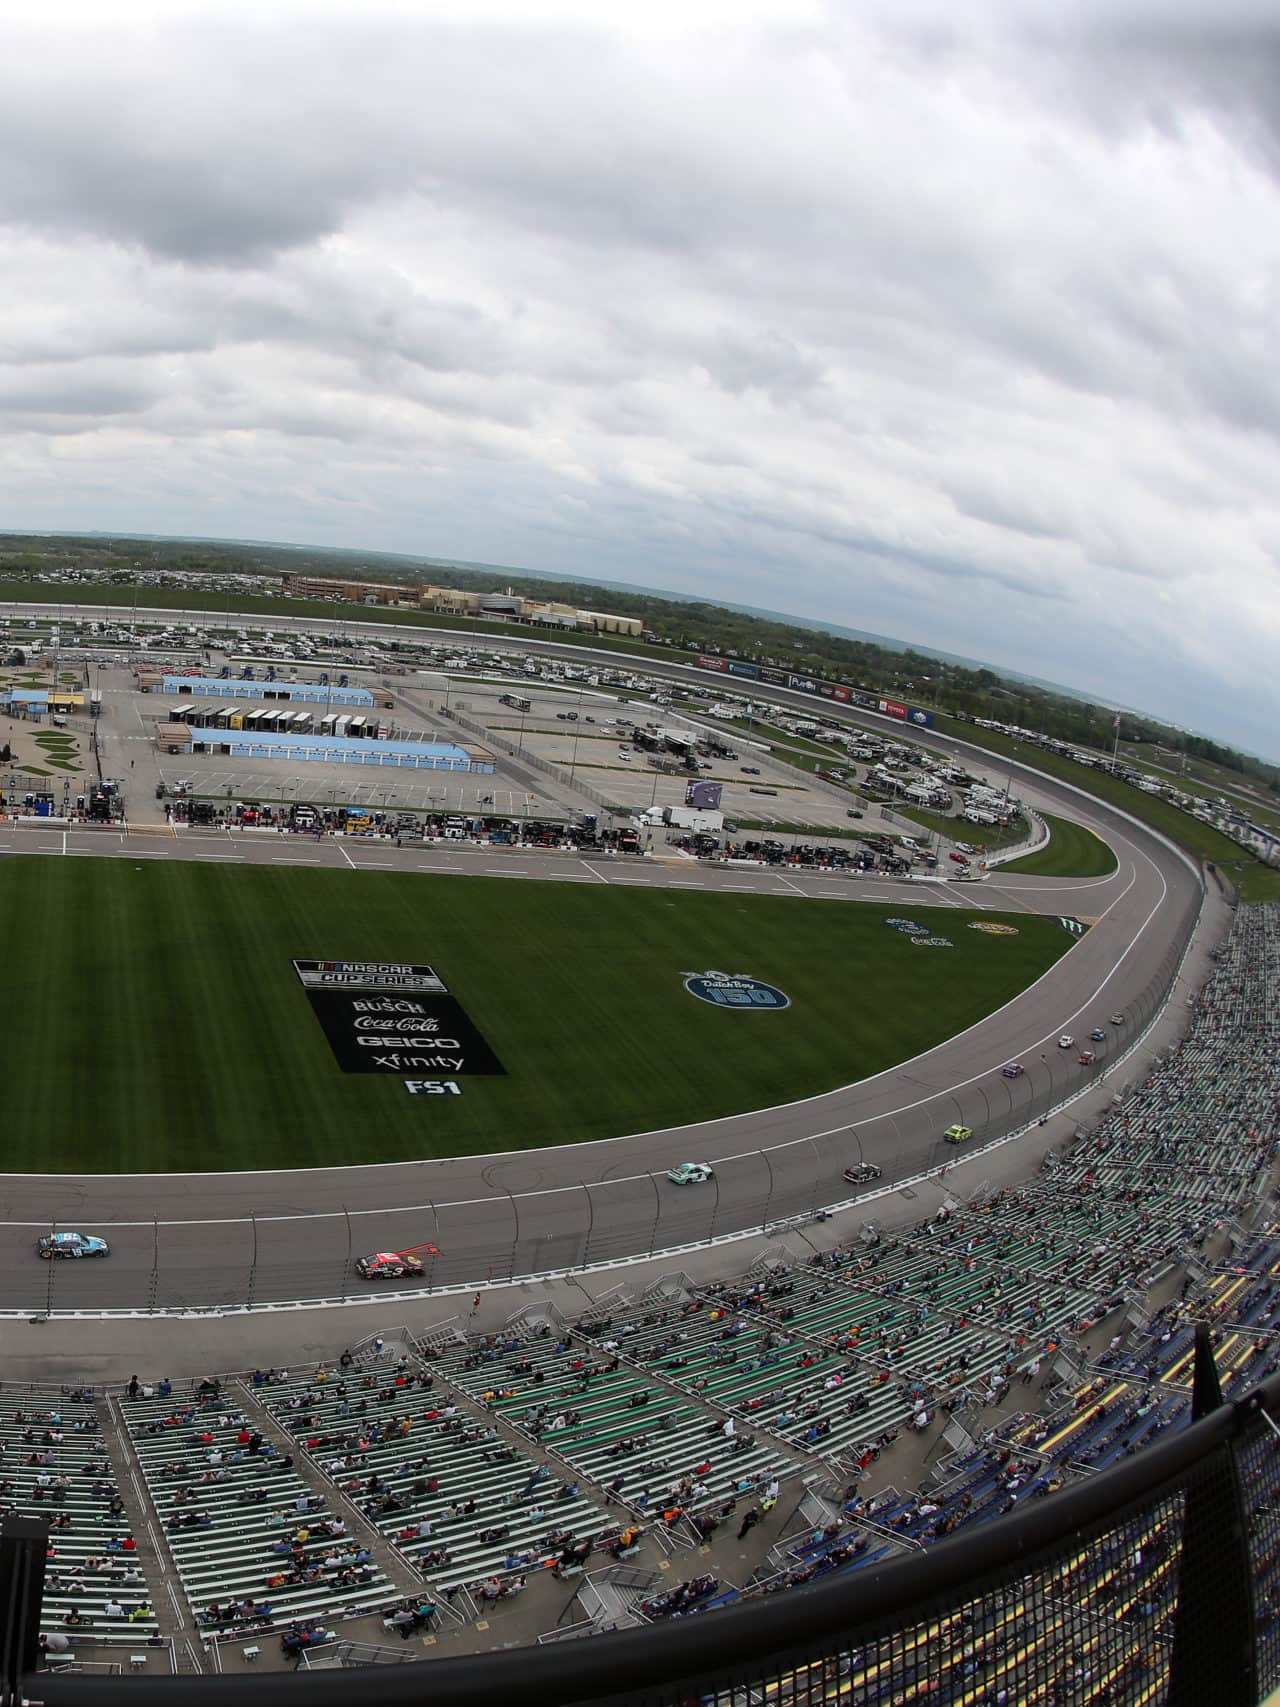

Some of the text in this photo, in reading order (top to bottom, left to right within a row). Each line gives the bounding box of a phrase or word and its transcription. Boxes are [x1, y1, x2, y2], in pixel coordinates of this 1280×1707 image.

[342, 962, 413, 975] NASCAR
[320, 973, 424, 986] CUP SERIES
[701, 980, 755, 990] Dutch Boy
[706, 988, 777, 1004] 150
[352, 1000, 425, 1014] BUSCH
[356, 1036, 461, 1049] GEICO
[371, 1053, 465, 1071] xfinity
[403, 1080, 462, 1095] FS1
[392, 1267, 404, 1276] 3
